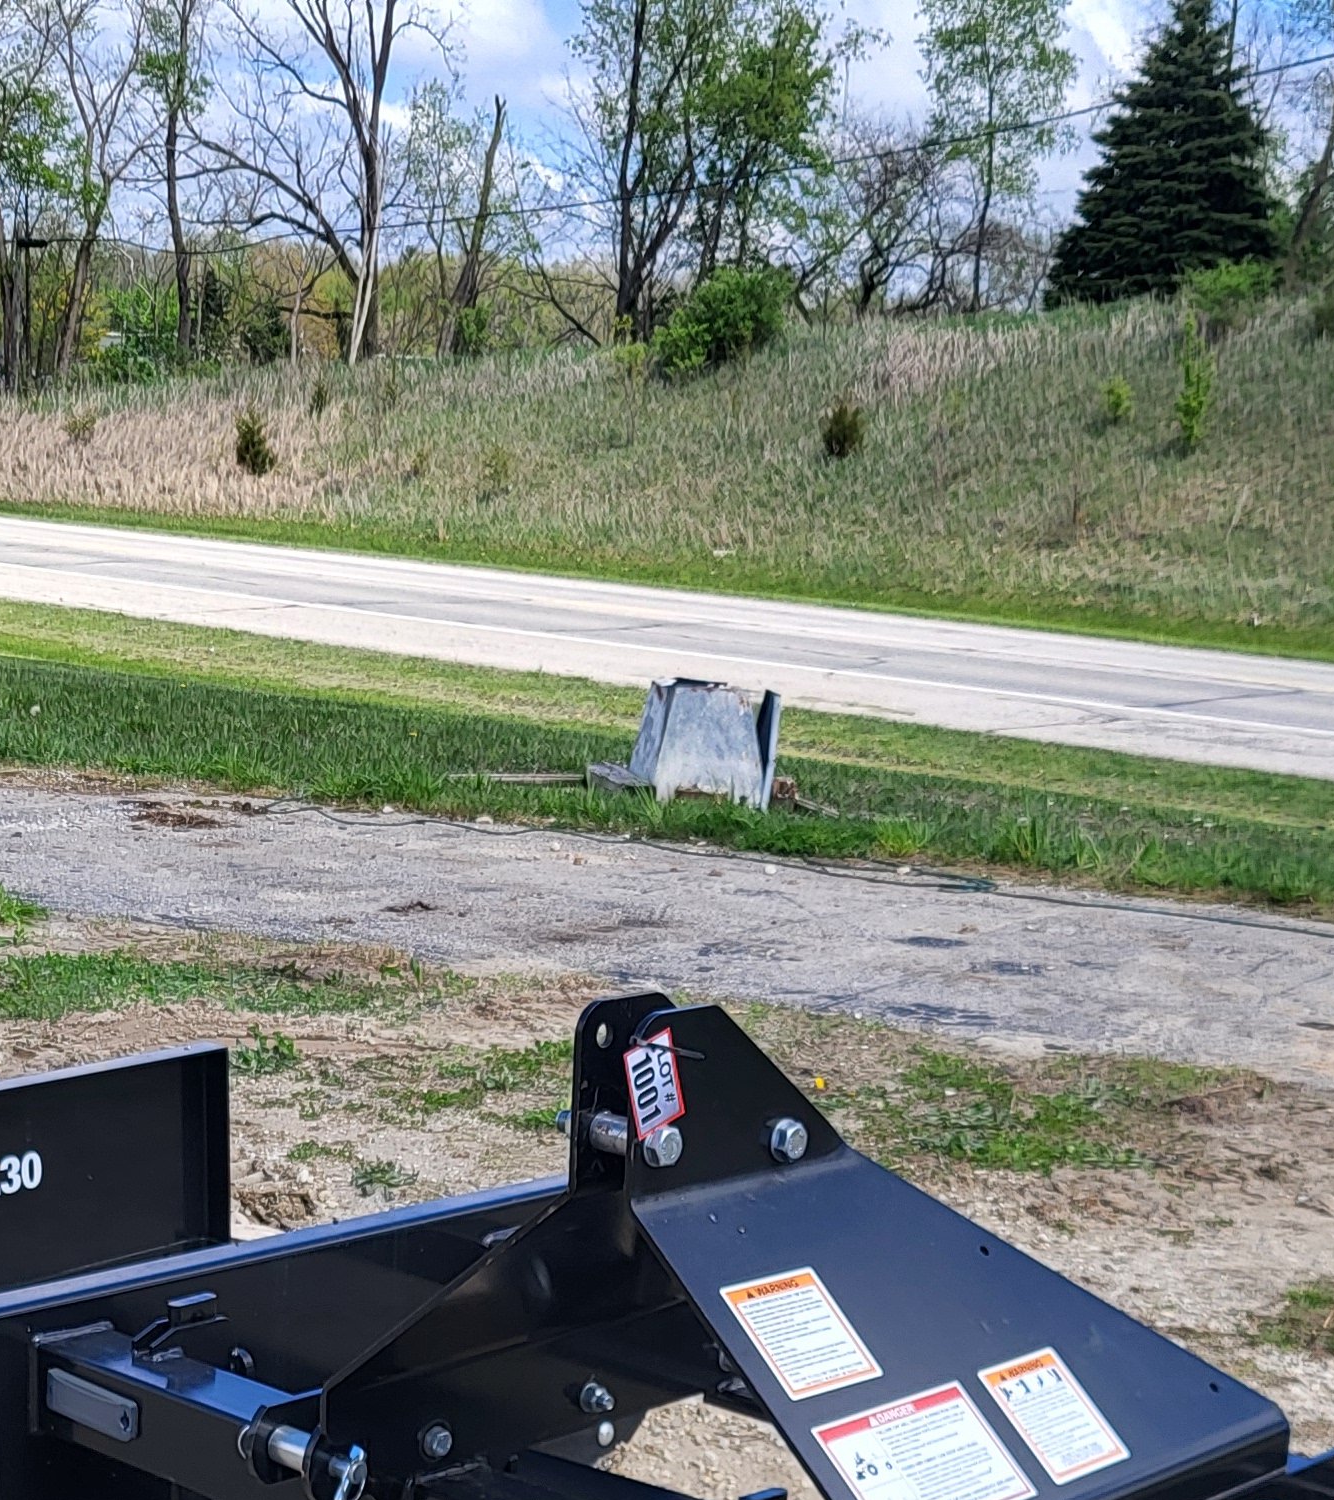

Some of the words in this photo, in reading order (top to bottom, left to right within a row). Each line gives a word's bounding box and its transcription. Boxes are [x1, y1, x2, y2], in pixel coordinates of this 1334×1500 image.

[656, 1047, 674, 1088] LOT
[631, 1052, 662, 1126] 1001
[755, 1279, 800, 1297] WARNING
[876, 1403, 917, 1425] DANGER
